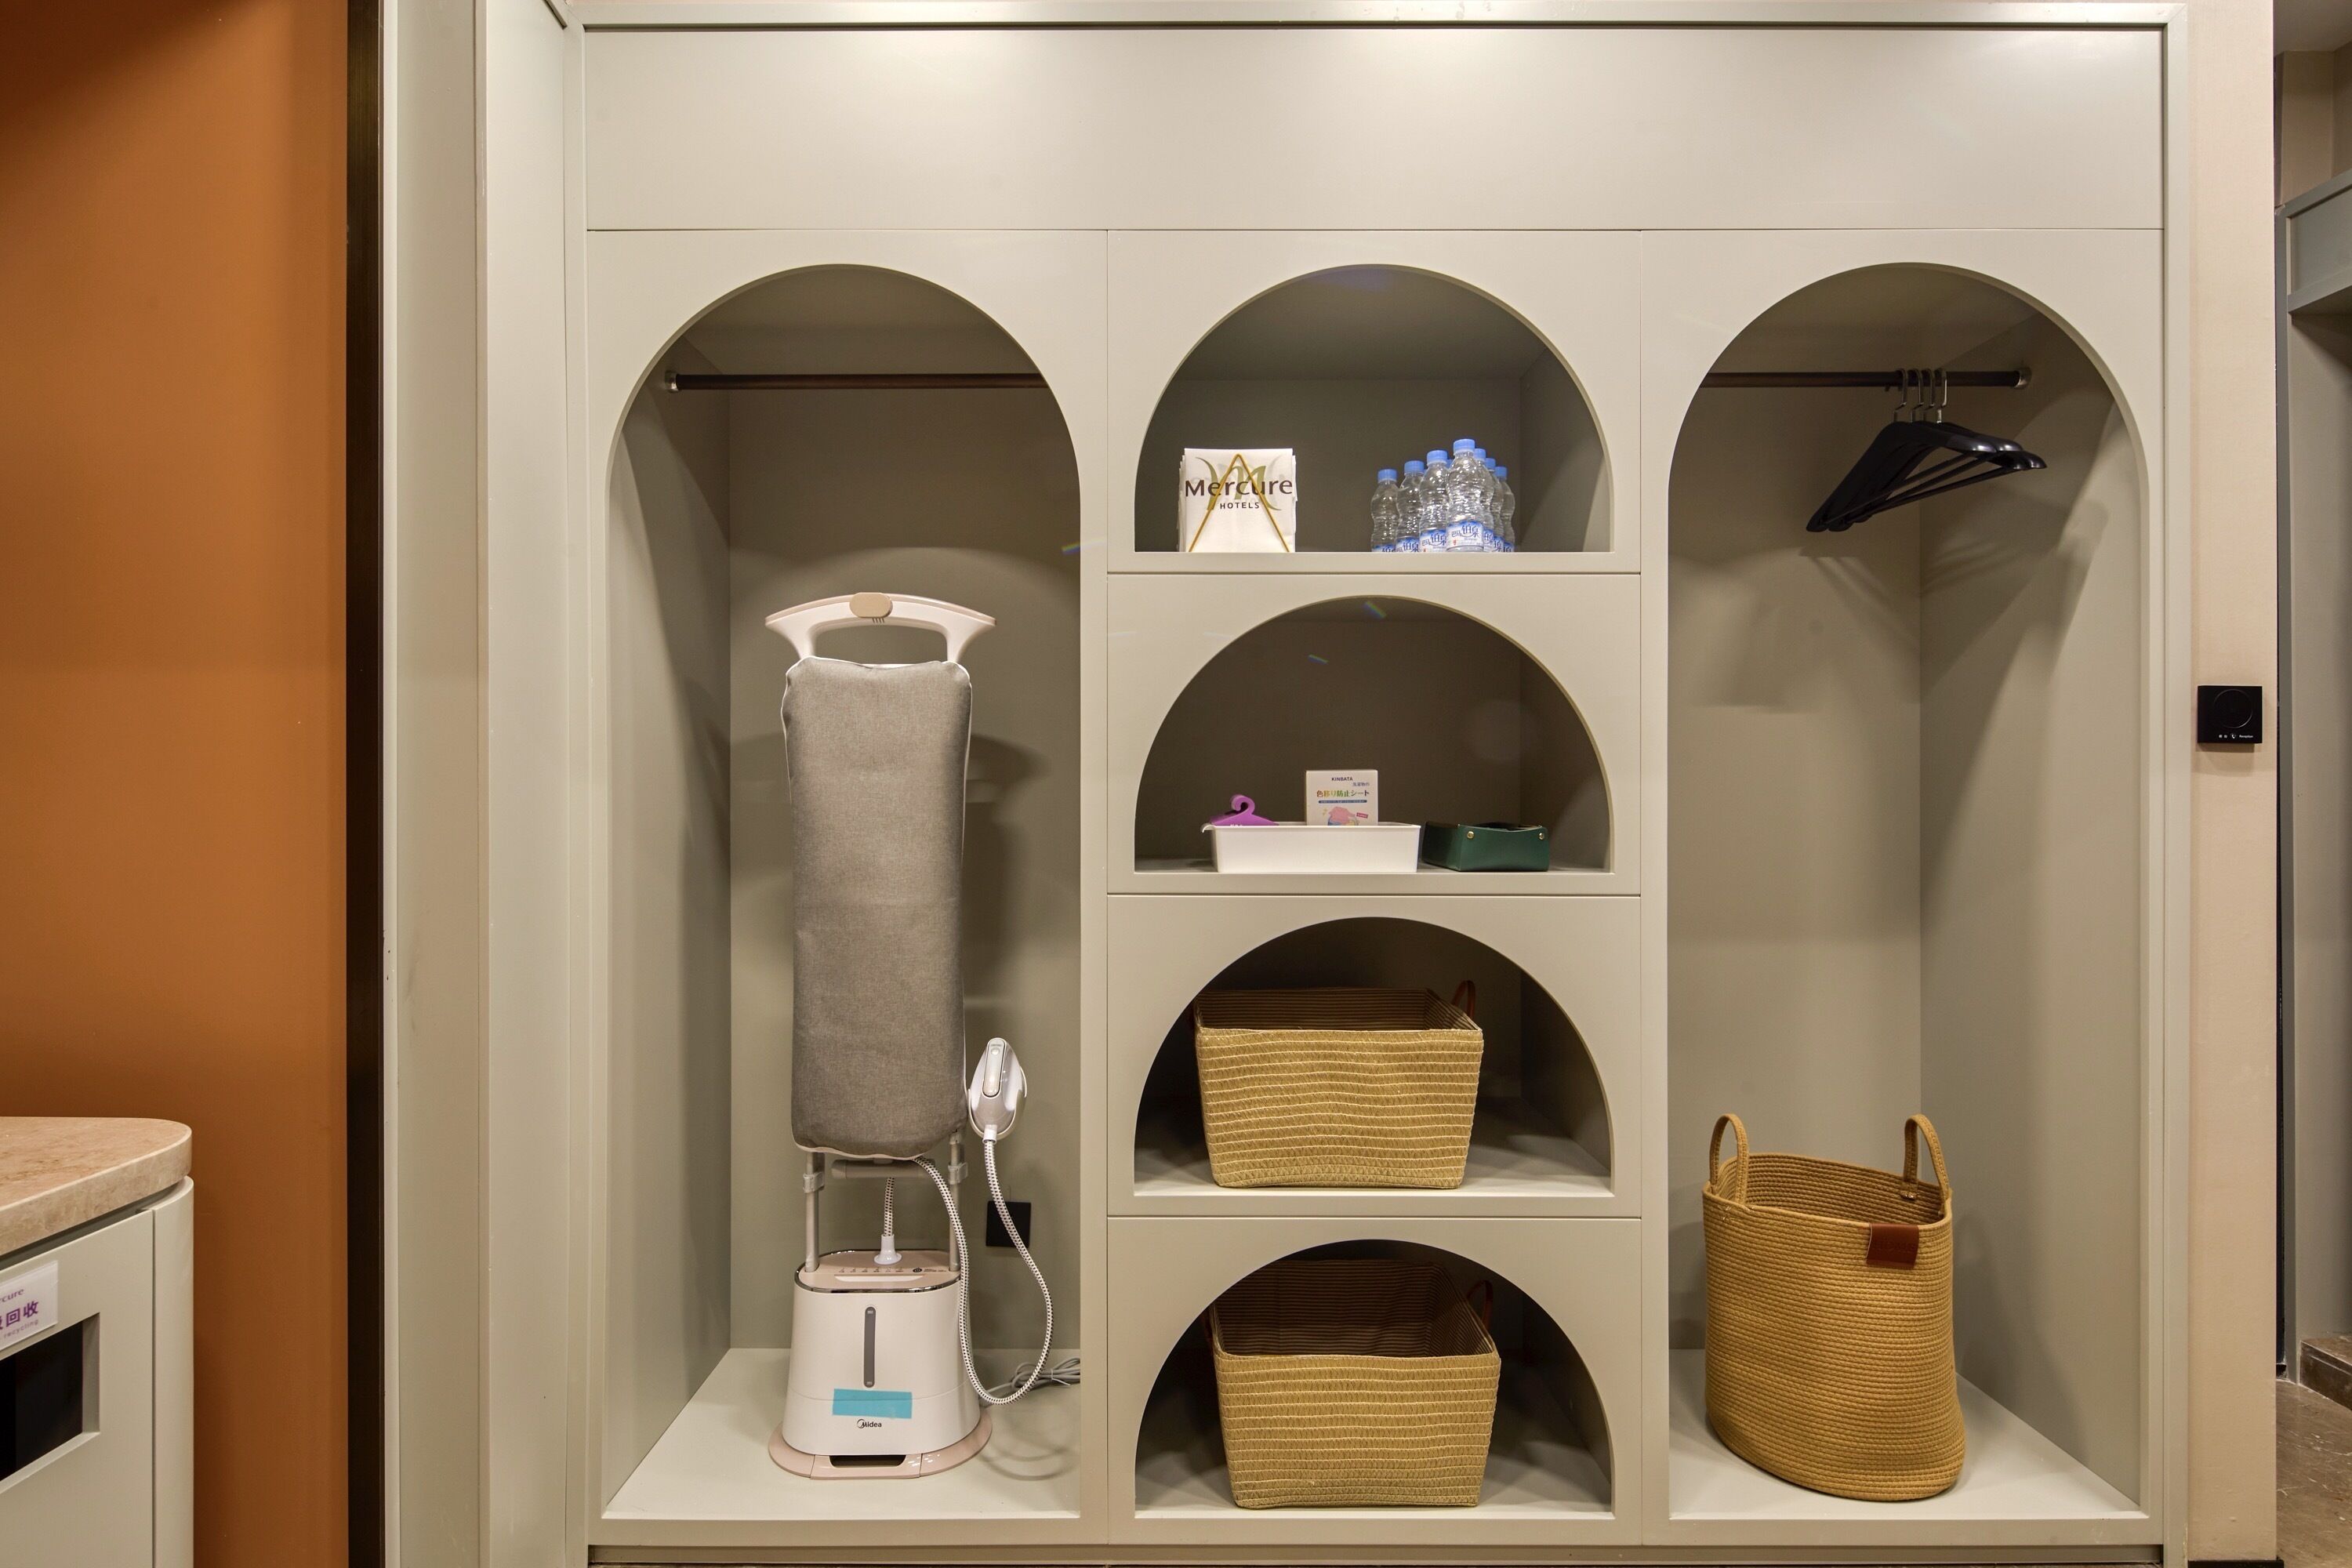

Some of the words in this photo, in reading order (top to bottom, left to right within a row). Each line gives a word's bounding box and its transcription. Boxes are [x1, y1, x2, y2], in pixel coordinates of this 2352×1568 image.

[1185, 479, 1293, 497] Mercure
[1316, 789, 1370, 798] 色移り防止シート
[4, 1319, 38, 1338] recycling
[857, 1418, 882, 1428] Midea
